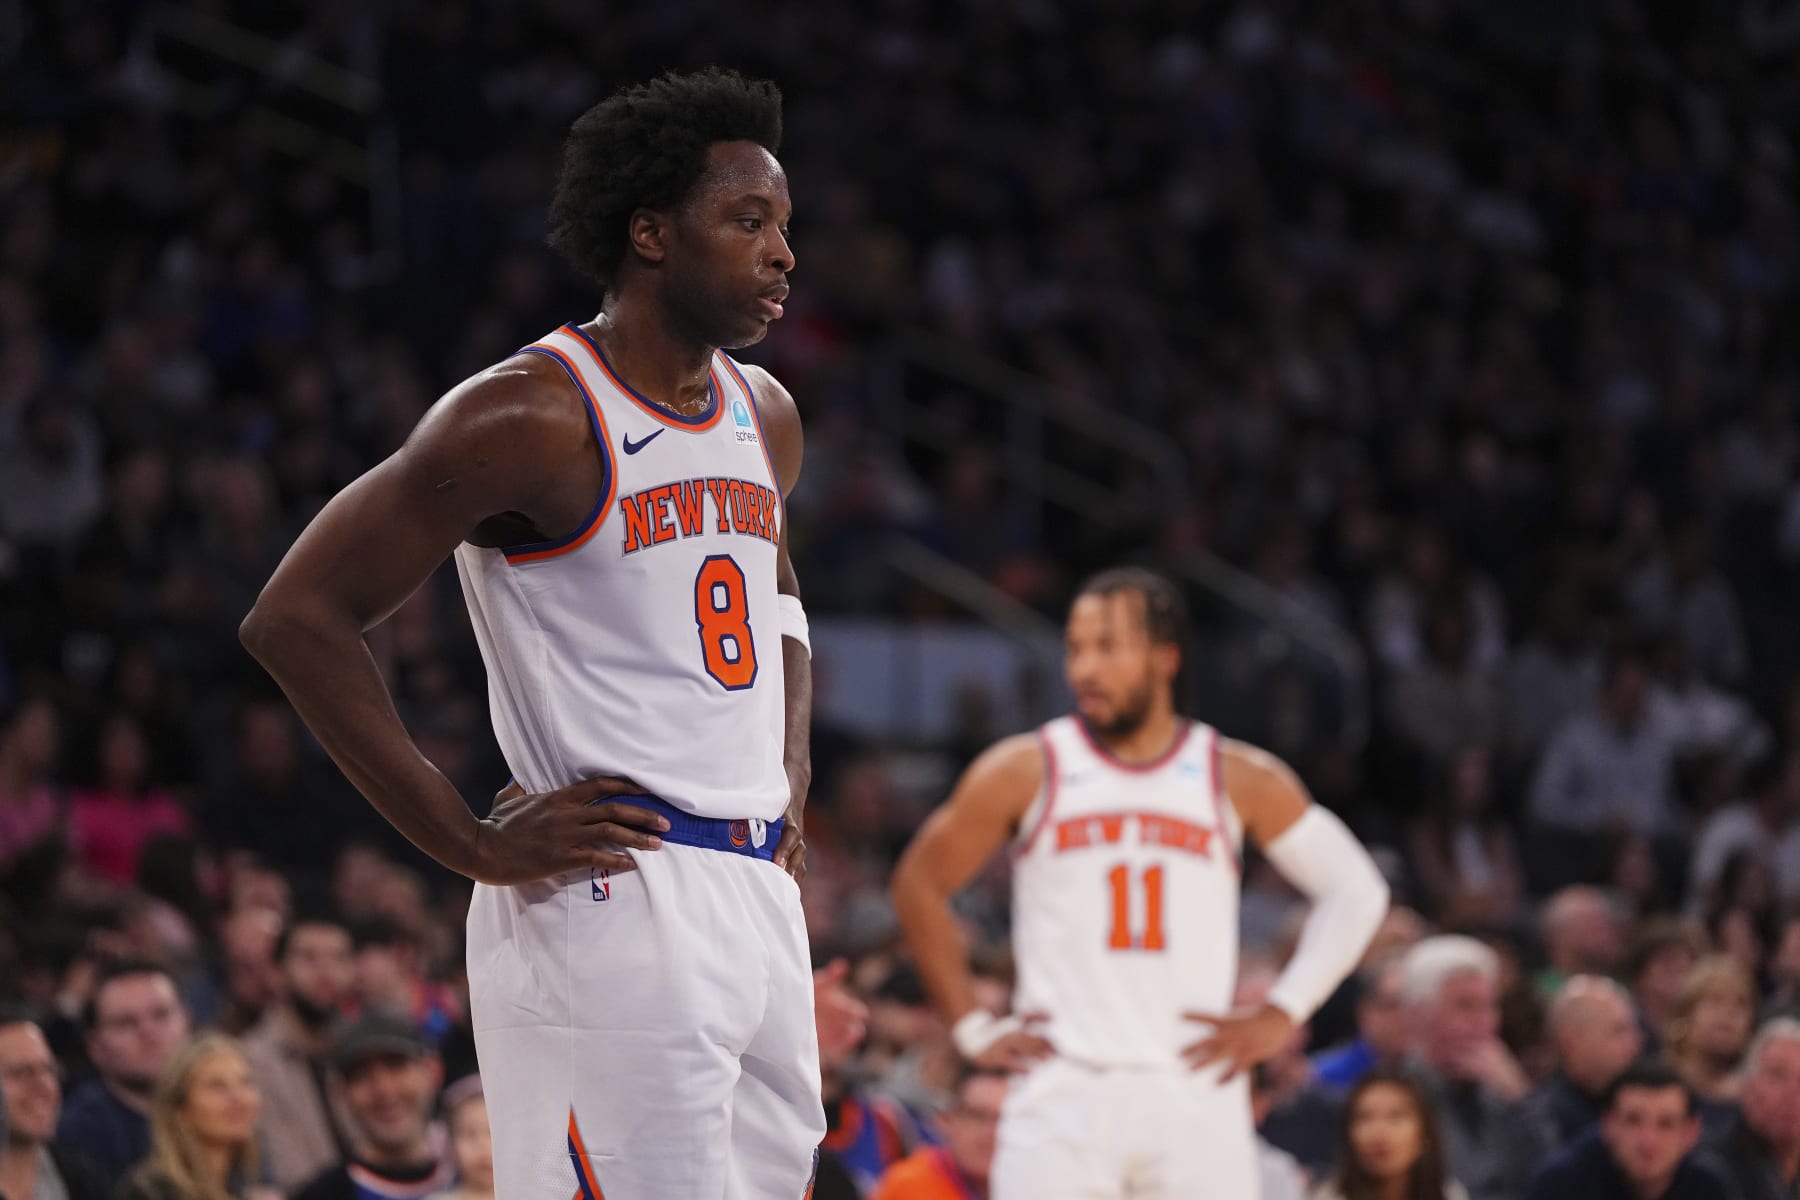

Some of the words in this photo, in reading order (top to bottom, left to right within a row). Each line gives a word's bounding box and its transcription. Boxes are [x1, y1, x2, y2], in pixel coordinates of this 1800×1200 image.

[735, 430, 758, 443] sphere
[619, 478, 705, 555] NEW
[706, 477, 779, 546] YORK
[694, 553, 758, 691] 8
[1056, 812, 1124, 853] NEW
[1136, 812, 1213, 860] YORK
[1107, 862, 1166, 951] 11
